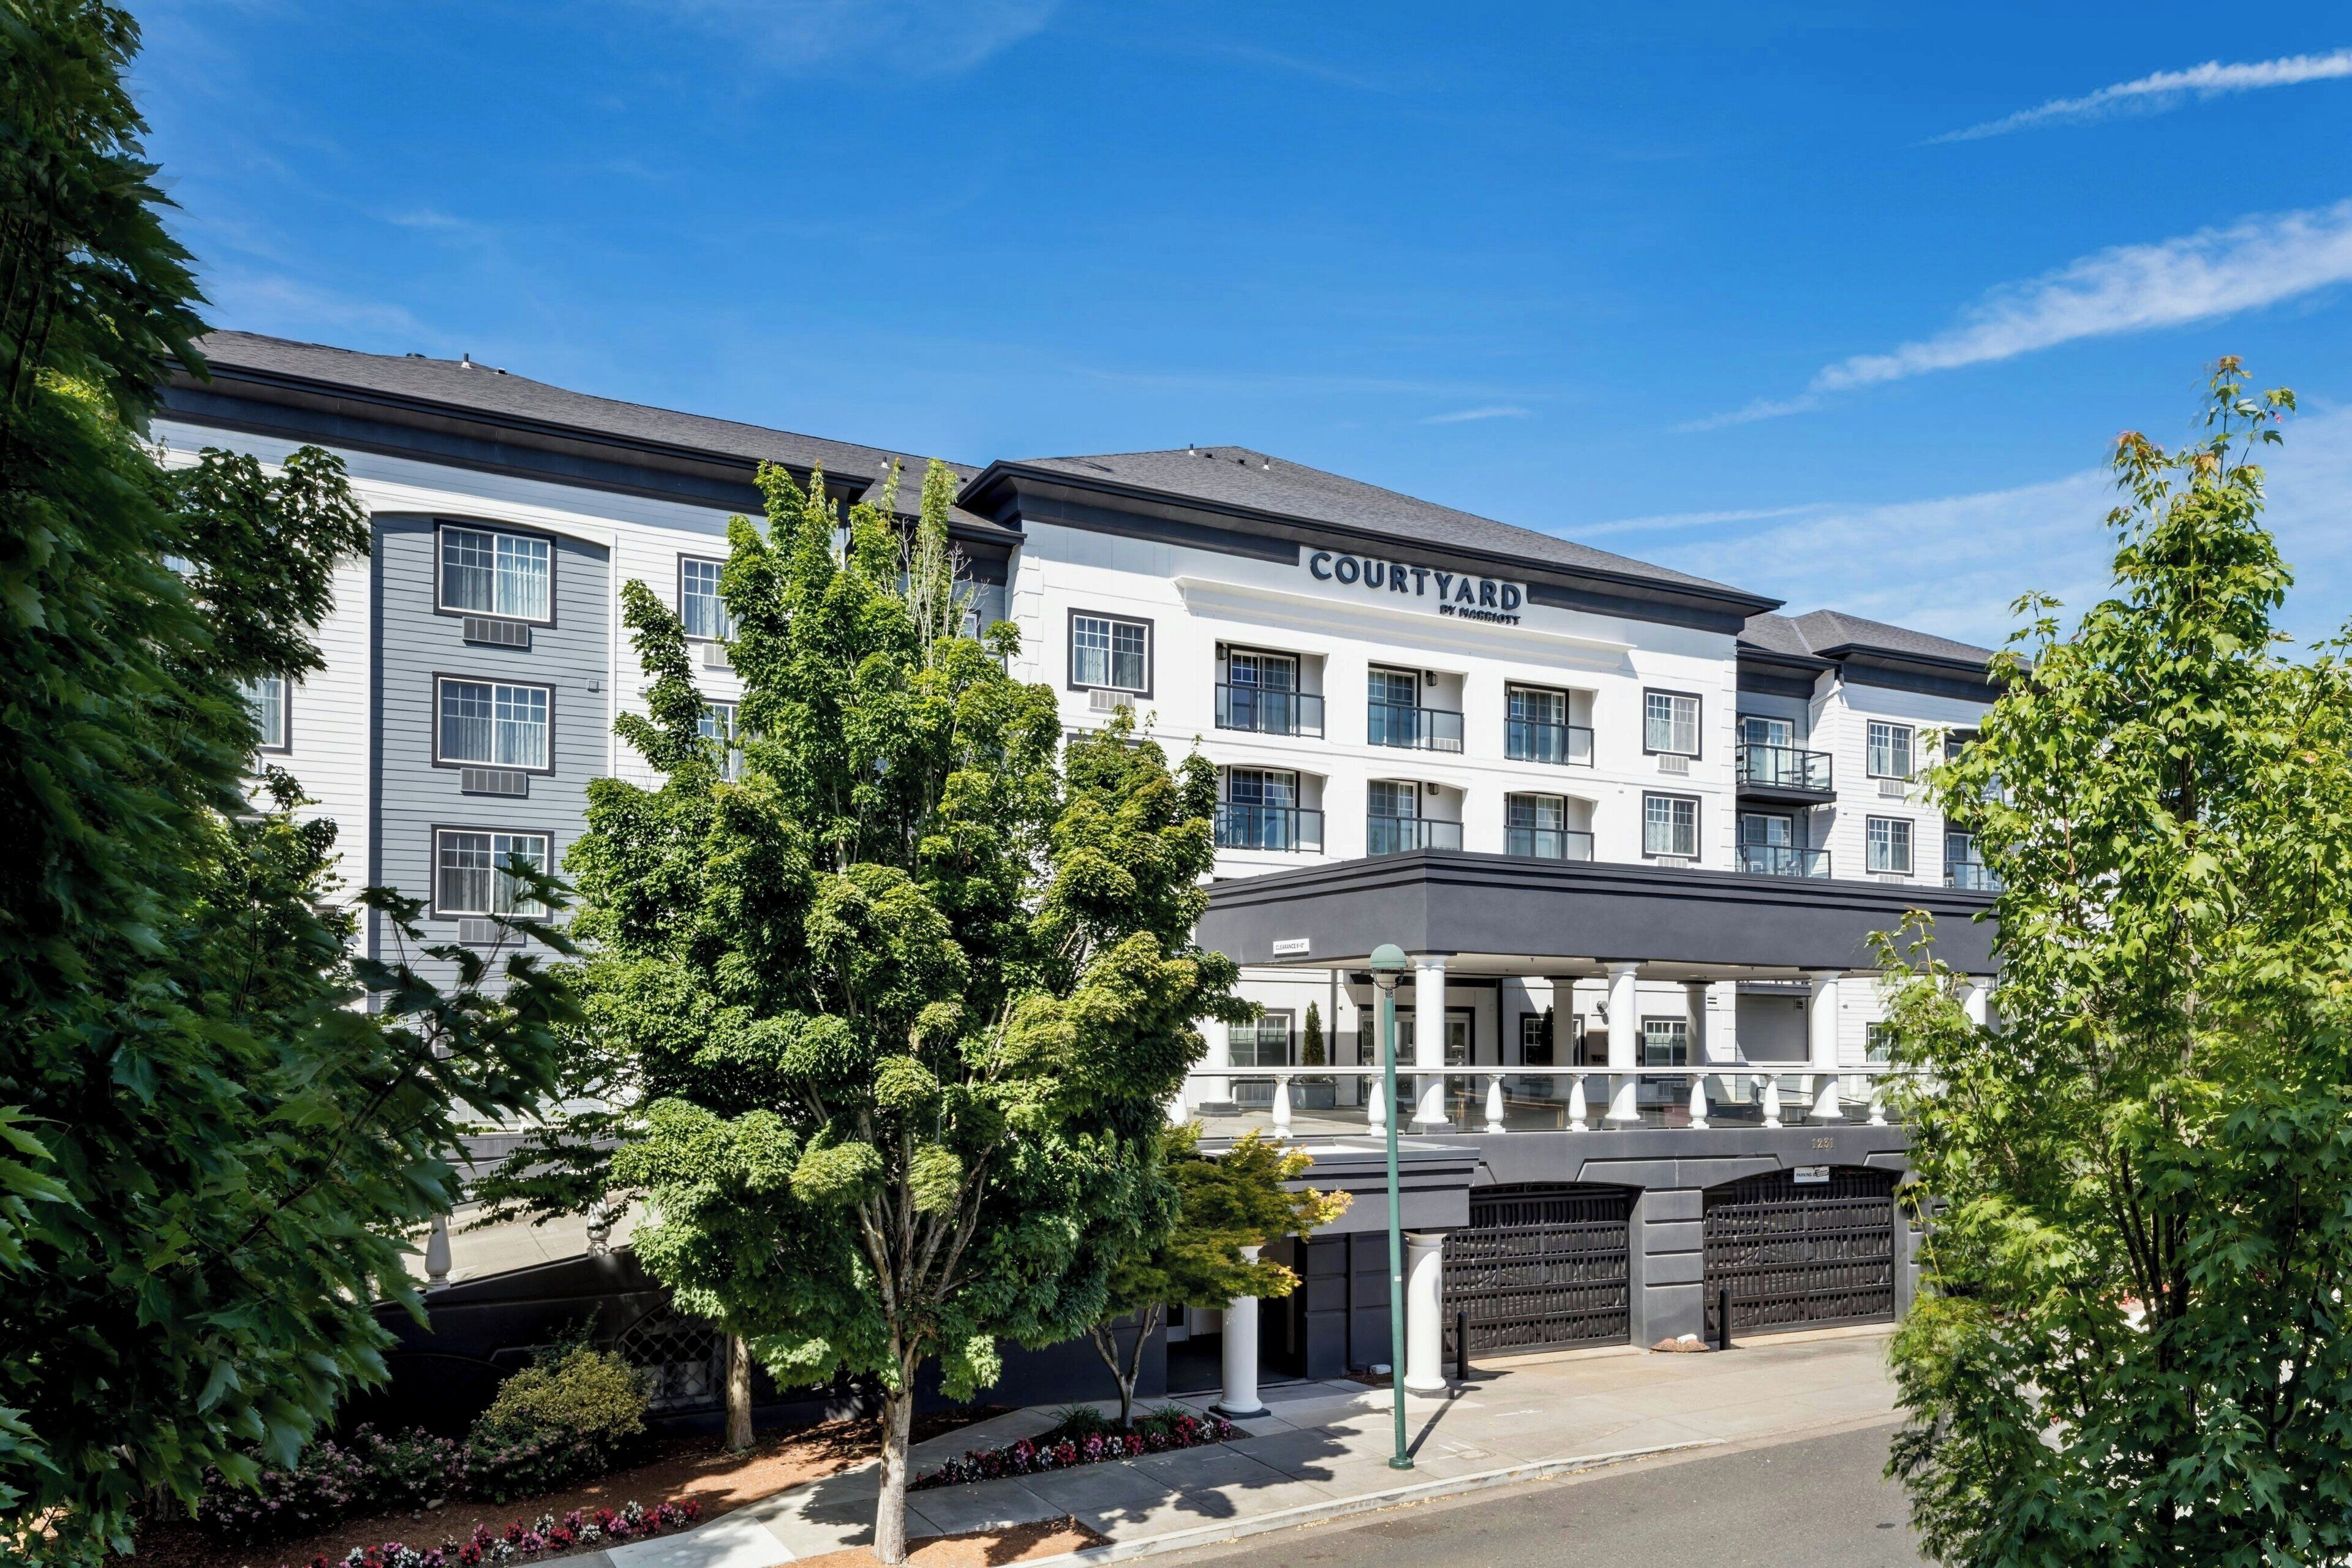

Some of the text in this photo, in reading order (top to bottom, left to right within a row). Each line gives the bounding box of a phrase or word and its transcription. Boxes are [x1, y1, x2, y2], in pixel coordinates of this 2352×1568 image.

[1310, 552, 1521, 610] COURTYARD
[1440, 605, 1521, 625] BY MARRIOTT
